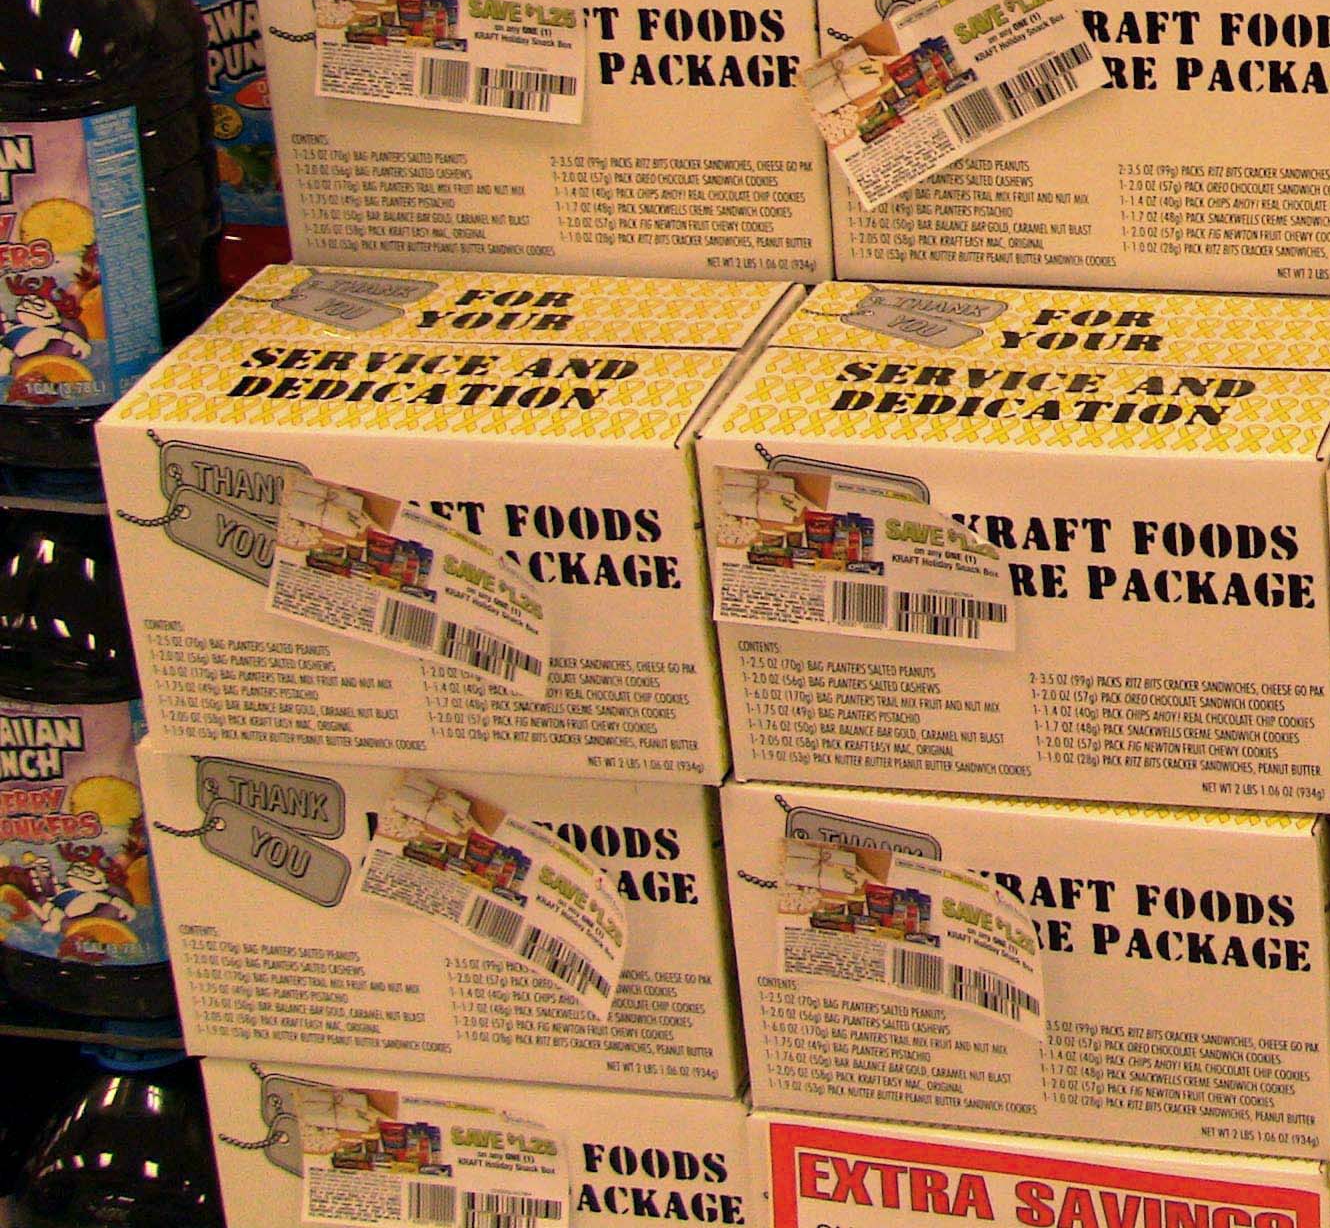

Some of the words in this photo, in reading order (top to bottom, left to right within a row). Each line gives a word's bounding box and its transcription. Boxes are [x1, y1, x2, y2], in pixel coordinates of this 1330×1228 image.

[639, 7, 786, 43] FOODS
[600, 53, 801, 87] PACKAGE
[456, 289, 575, 307] FOR
[416, 311, 575, 331] YOUR
[1032, 309, 1156, 328] FOR
[998, 331, 1163, 352] YOUR
[240, 348, 499, 376] SERVICE
[514, 356, 641, 381] AND
[836, 360, 1101, 394] SERVICE
[1127, 373, 1257, 399] AND
[226, 376, 608, 411] DEDICATION
[832, 391, 1231, 426] DEDICATION
[504, 502, 663, 543] FOODS
[1133, 521, 1300, 561] FOODS
[1088, 566, 1317, 610] PACKAGE
[226, 775, 330, 824] THANK
[249, 826, 311, 878] YOU
[797, 1151, 994, 1220] EXTRA
